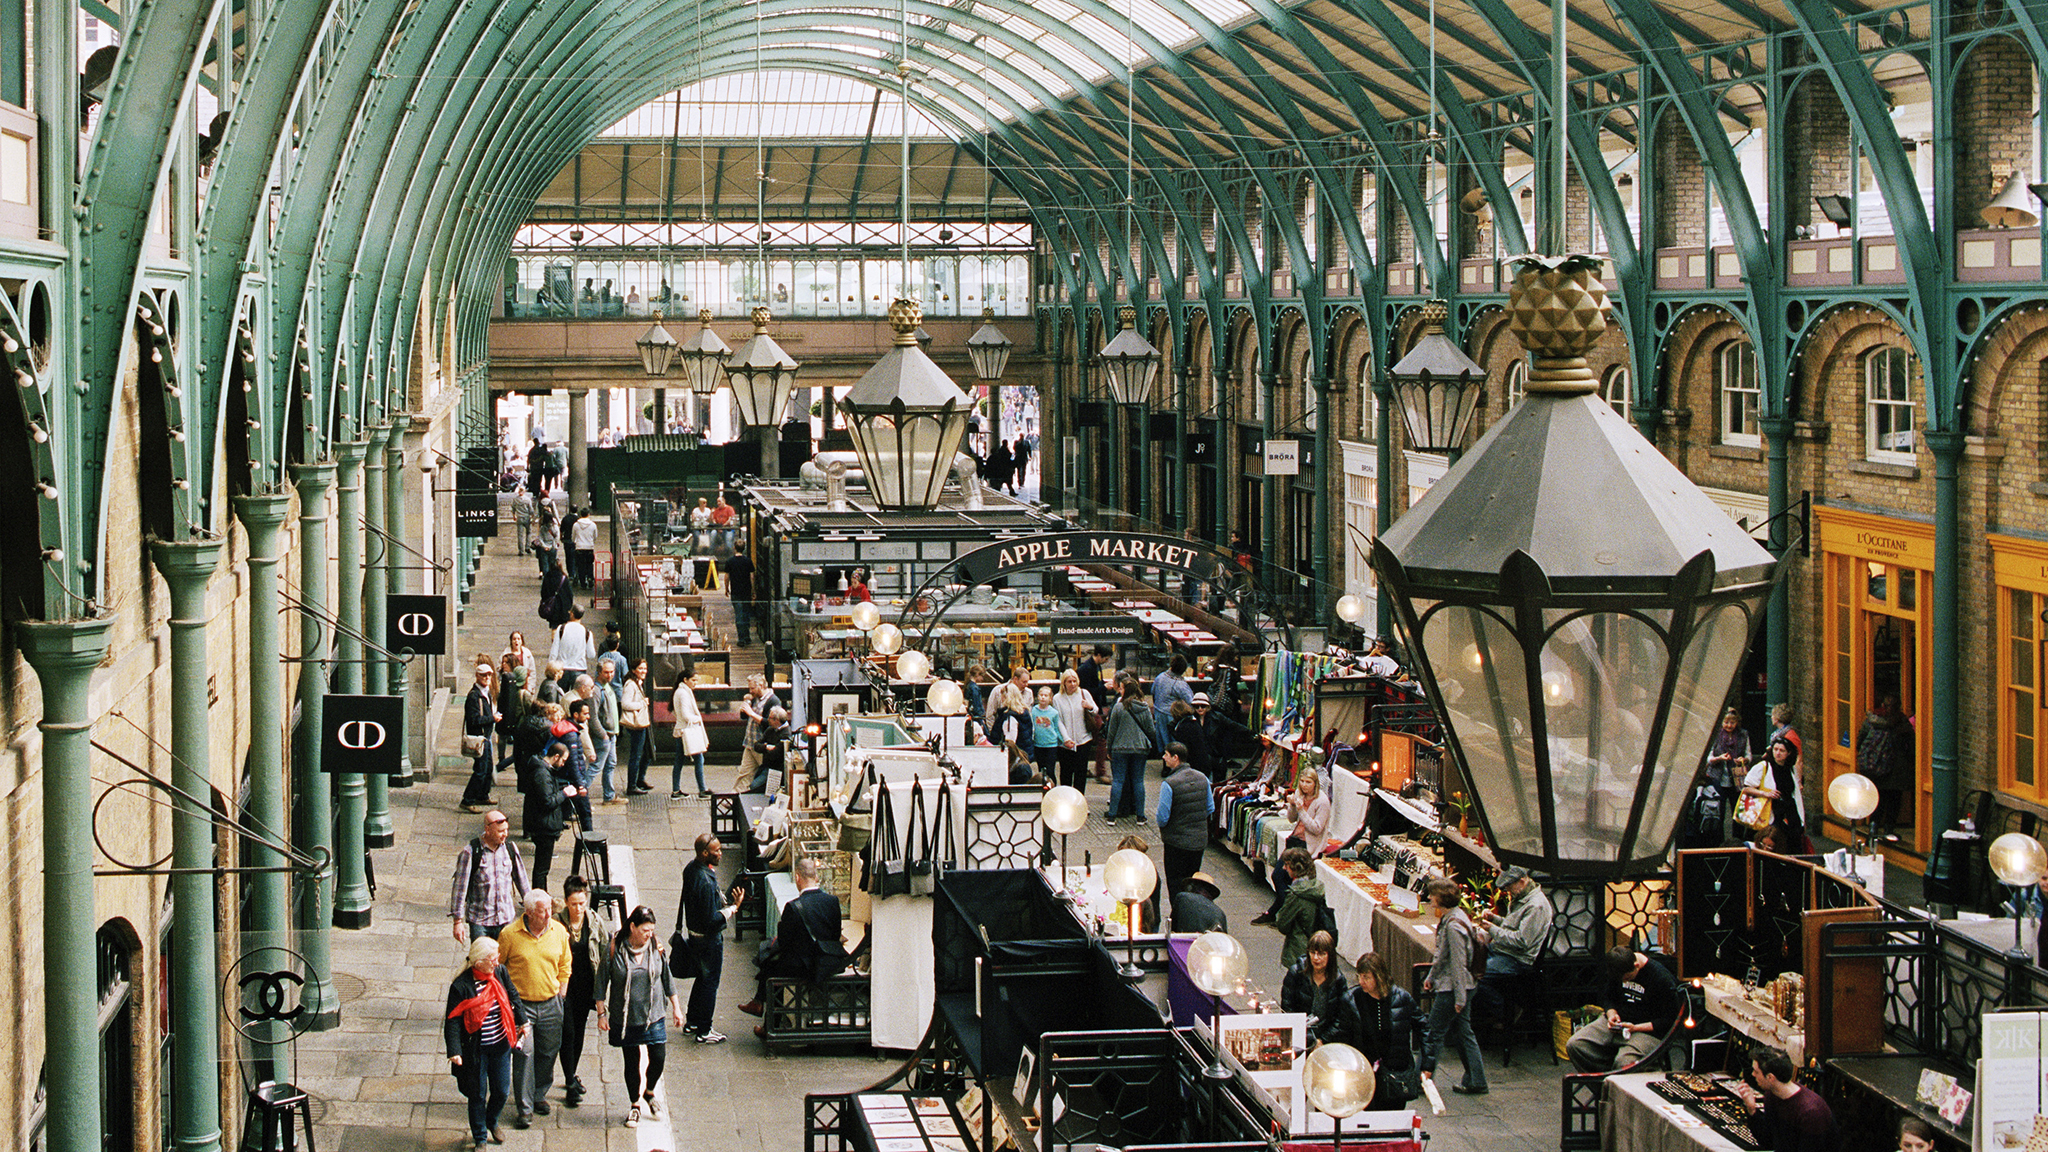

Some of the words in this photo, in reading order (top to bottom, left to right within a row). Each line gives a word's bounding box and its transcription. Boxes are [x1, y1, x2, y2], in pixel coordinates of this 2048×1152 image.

[457, 510, 495, 518] LINKS
[1857, 532, 1908, 552] L'OCCITANE
[997, 539, 1073, 570] APPLE
[1089, 538, 1198, 569] MARKET
[1057, 626, 1094, 634] Hand-made
[1111, 626, 1134, 635] Design
